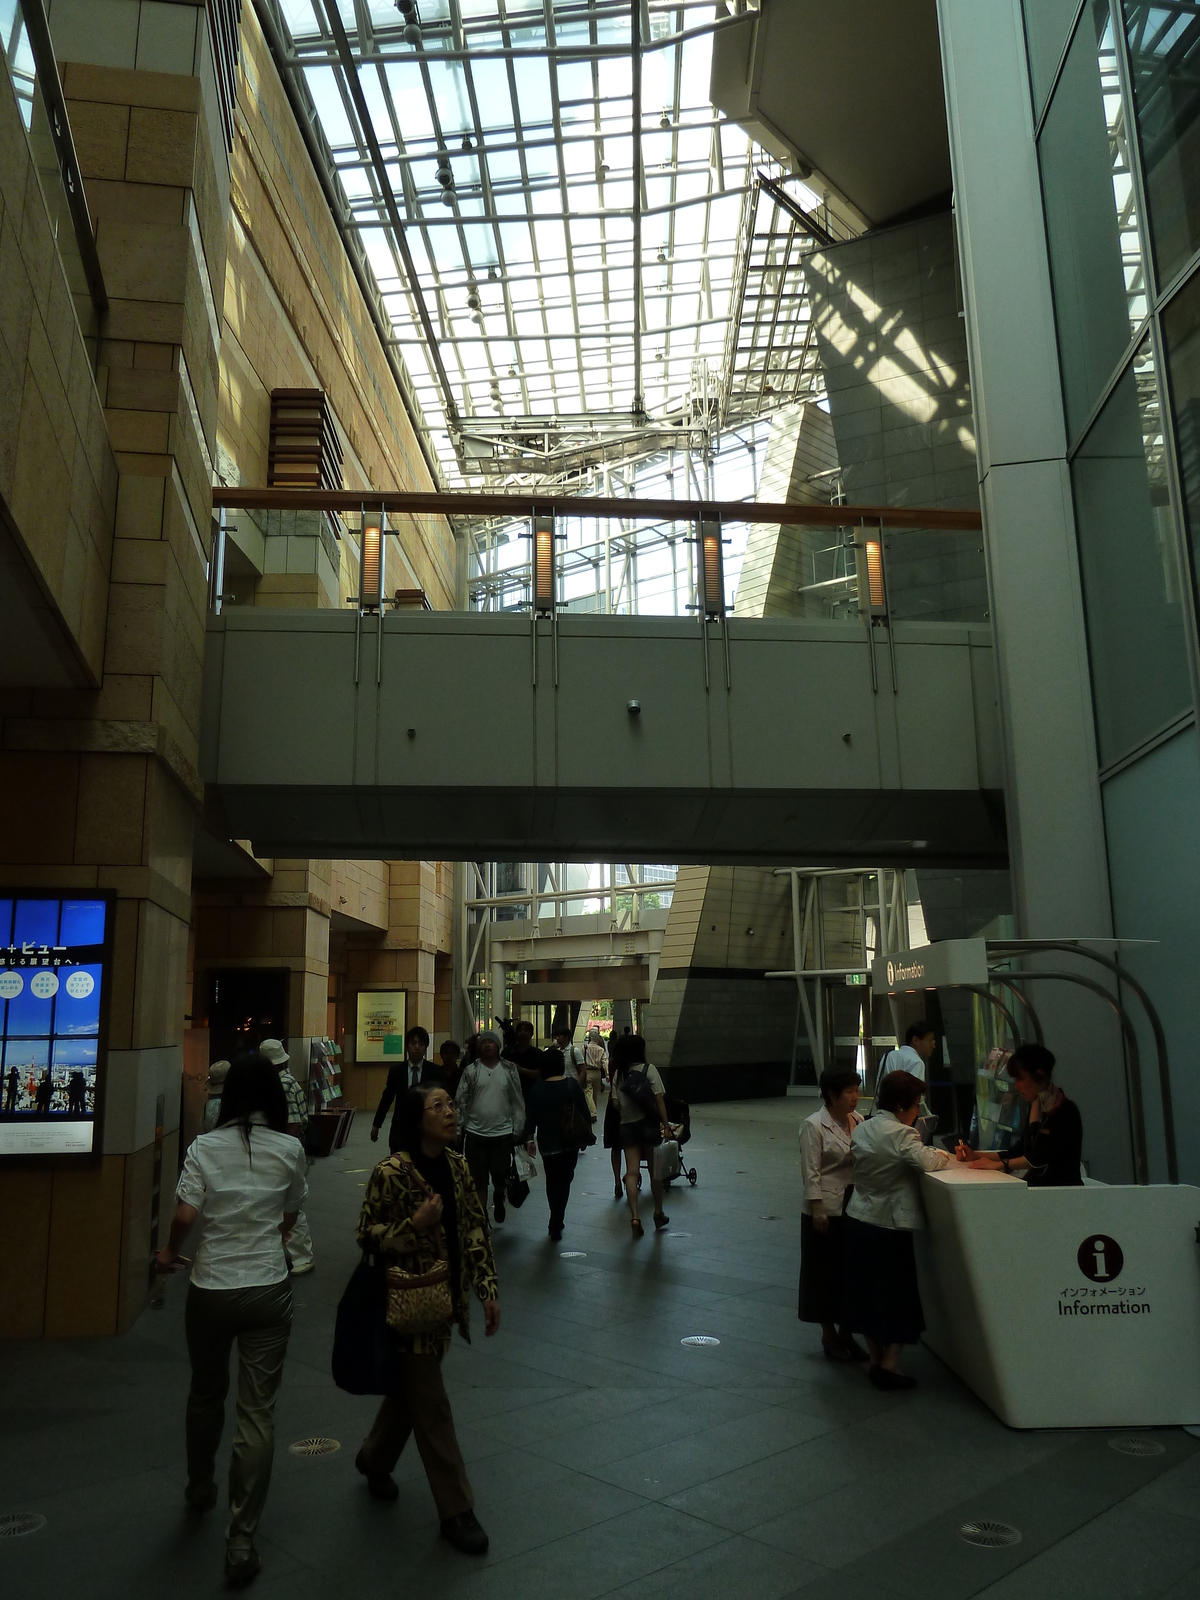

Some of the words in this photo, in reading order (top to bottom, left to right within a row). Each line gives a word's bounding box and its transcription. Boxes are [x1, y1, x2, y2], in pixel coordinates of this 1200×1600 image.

[895, 961, 924, 981] Information
[1060, 1286, 1146, 1298] インフォメーション
[1058, 1300, 1151, 1316] Information
